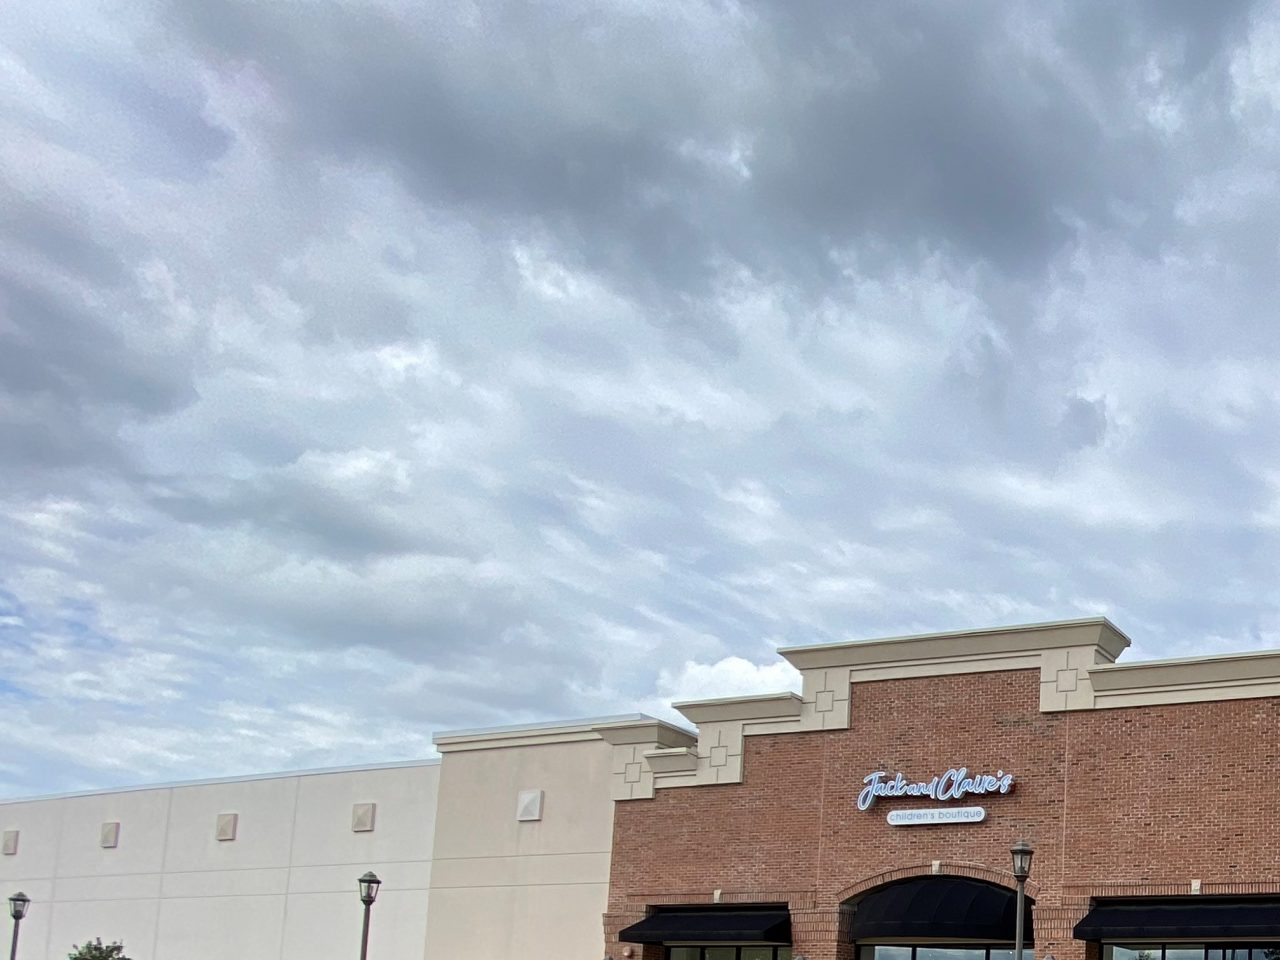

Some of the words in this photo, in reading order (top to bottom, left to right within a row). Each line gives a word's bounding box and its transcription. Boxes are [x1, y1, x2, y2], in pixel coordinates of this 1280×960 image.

[857, 772, 907, 810] Jack
[907, 777, 938, 799] and
[937, 767, 1013, 801] Claire's
[890, 811, 935, 822] children's
[938, 809, 982, 821] boutique
